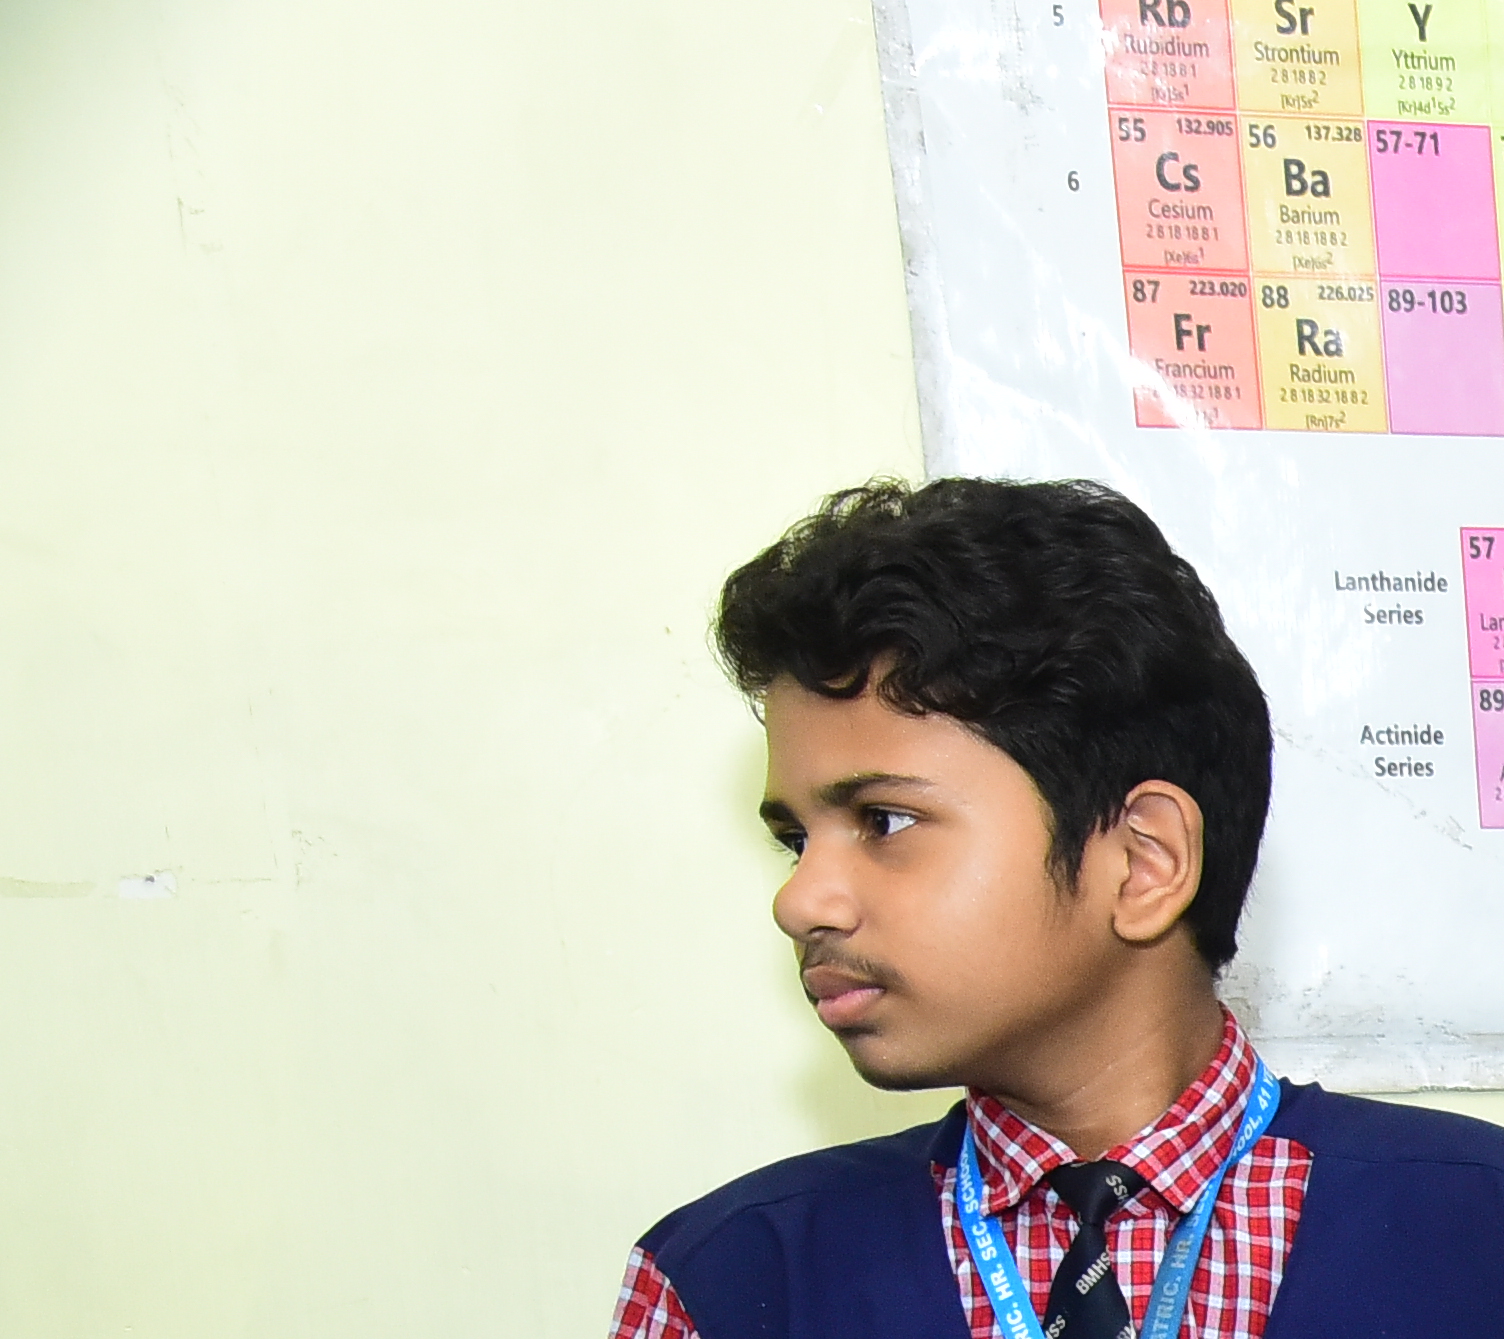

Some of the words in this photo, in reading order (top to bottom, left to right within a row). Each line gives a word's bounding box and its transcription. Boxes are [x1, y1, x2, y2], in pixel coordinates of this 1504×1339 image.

[1407, 2, 1433, 43] Y
[1253, 40, 1340, 65] Strontium
[1375, 129, 1440, 156] 57-71
[1067, 170, 1080, 192] 6
[1155, 151, 1201, 193] Cs
[1283, 157, 1331, 199] Ba
[1148, 198, 1213, 220] Cesium
[1279, 204, 1340, 225] Barium
[1387, 288, 1468, 315] 89-103
[1173, 312, 1212, 352] Fr
[1295, 318, 1344, 358] Ra
[1334, 570, 1449, 593] Lanthanide
[1363, 603, 1424, 625] Series
[1359, 723, 1444, 746] Actinide
[1374, 756, 1434, 777] Series
[990, 1263, 1014, 1301] HR.
